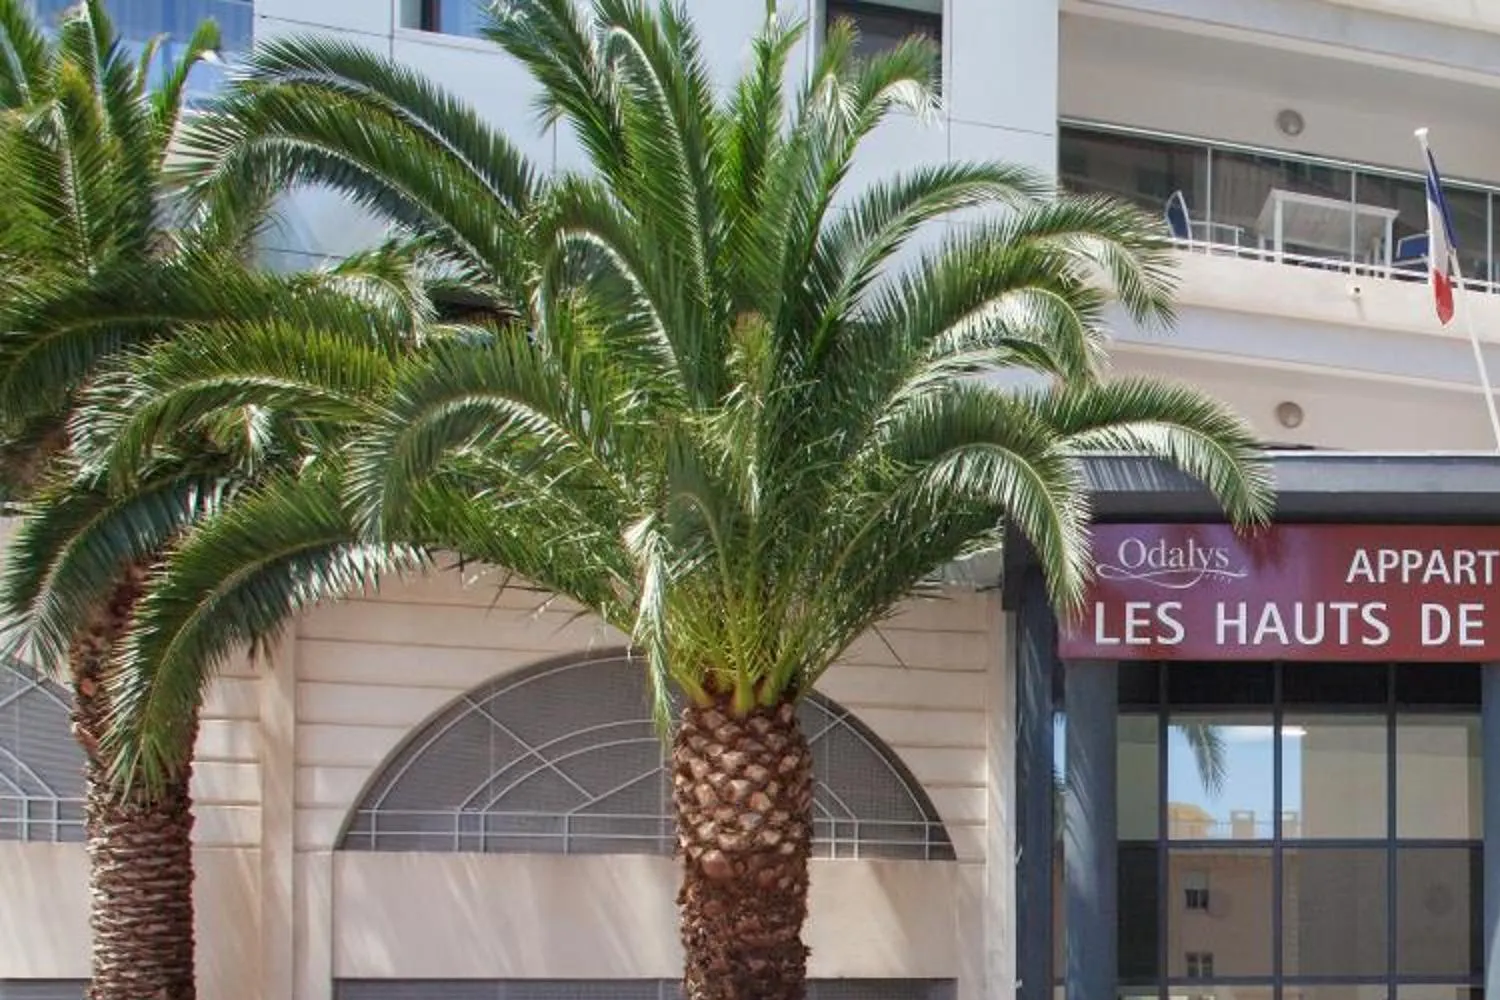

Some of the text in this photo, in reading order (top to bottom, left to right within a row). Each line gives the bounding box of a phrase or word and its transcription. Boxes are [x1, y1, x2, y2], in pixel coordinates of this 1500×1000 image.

[1117, 536, 1230, 572] Odalys
[1095, 601, 1185, 646] LES
[1215, 601, 1391, 646] HAUTS
[1421, 602, 1485, 647] DE
